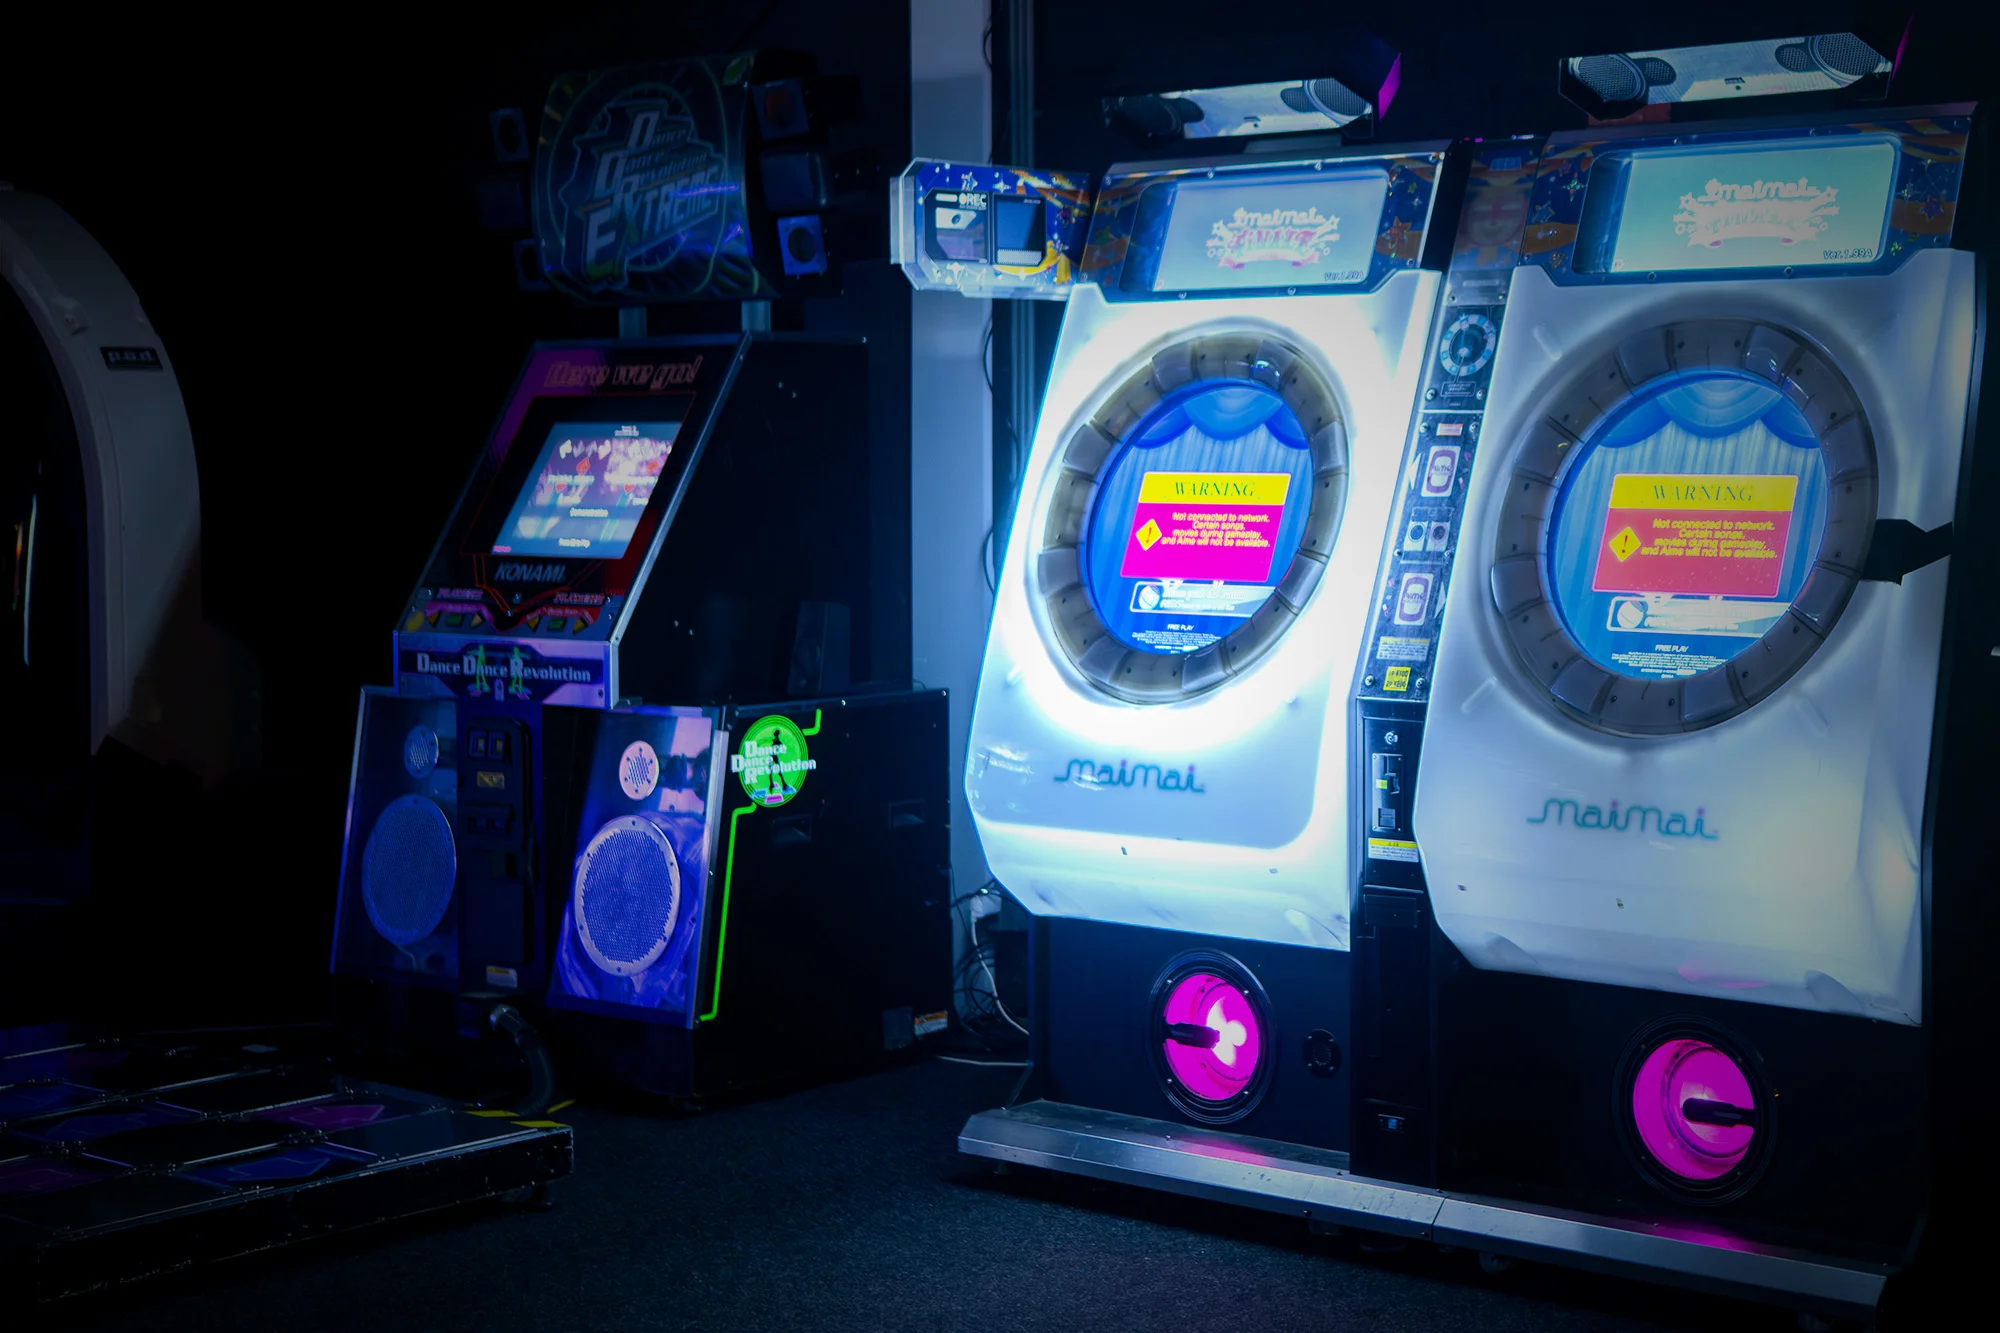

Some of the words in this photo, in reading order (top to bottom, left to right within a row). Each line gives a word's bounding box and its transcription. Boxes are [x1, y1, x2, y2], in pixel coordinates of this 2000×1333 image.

[966, 193, 987, 206] REC
[1175, 482, 1256, 497] WARNING
[1653, 485, 1754, 501] WARNING
[1172, 512, 1187, 521] Not
[1187, 512, 1228, 522] connected
[1228, 513, 1237, 522] to
[1192, 521, 1220, 530] Certain
[1652, 519, 1671, 528] Not
[1671, 520, 1722, 529] connected
[1723, 520, 1733, 529] to
[1172, 529, 1199, 537] movies
[1199, 529, 1224, 538] during
[1679, 528, 1713, 538] Certain
[1161, 537, 1176, 545] and
[1197, 538, 1209, 546] will
[1209, 538, 1223, 546] not
[1223, 538, 1234, 547] be
[1654, 538, 1687, 546] movies
[1688, 538, 1718, 548] during
[1641, 546, 1659, 555] and
[1685, 547, 1700, 556] will
[1701, 548, 1718, 557] not
[1719, 548, 1732, 557] be
[494, 562, 566, 583] KONAMI
[1180, 624, 1195, 632] PLAY
[1655, 644, 1672, 652] FREE
[1672, 645, 1689, 653] PLAY
[416, 652, 460, 675] Dance
[463, 653, 508, 679] Dance
[509, 657, 592, 683] Revolution
[744, 740, 787, 759] Dance
[731, 754, 774, 774] Dance
[744, 758, 817, 785] Revolution
[1053, 759, 1205, 793] maimai
[1526, 797, 1719, 839] maimai
